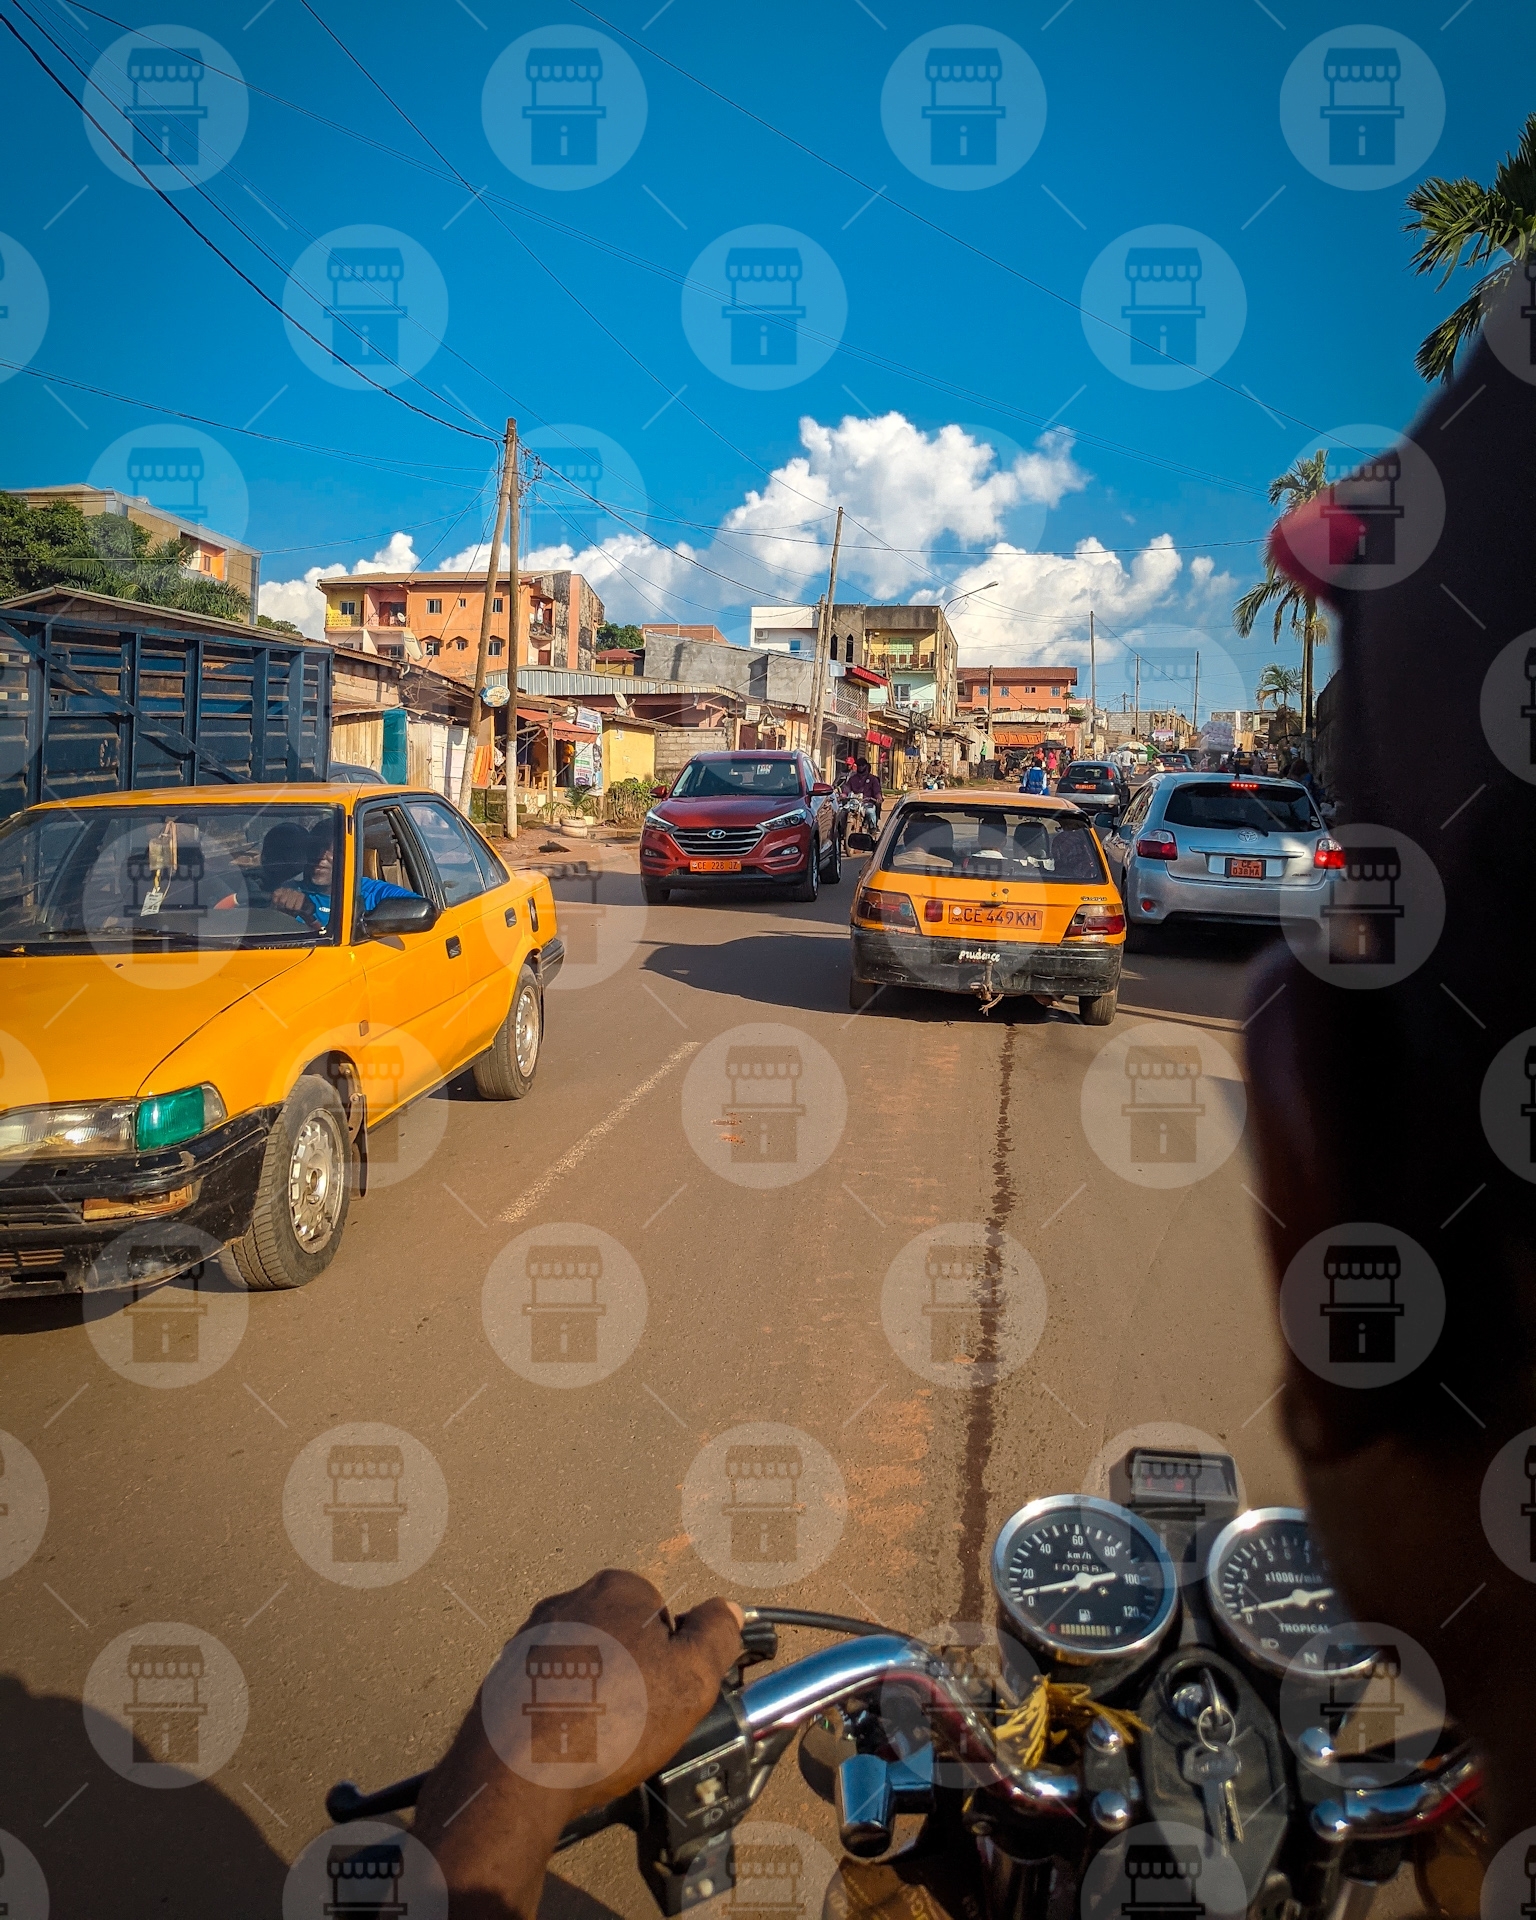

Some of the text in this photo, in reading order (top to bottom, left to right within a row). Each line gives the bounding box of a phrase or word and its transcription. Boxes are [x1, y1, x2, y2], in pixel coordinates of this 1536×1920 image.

[697, 861, 707, 869] CE
[963, 908, 983, 923] CE
[1072, 1535, 1084, 1546] 60
[1040, 1543, 1051, 1554] 40
[1104, 1545, 1116, 1557] 80
[1067, 1551, 1092, 1560] km/h
[1267, 1551, 1275, 1562] 5
[1251, 1557, 1258, 1568] 4
[1022, 1568, 1034, 1579] 20
[1123, 1573, 1140, 1585] 100
[1241, 1568, 1249, 1580] 3
[1236, 1582, 1244, 1595] 2
[1028, 1596, 1035, 1607] 0
[1123, 1605, 1139, 1618] 120
[1245, 1612, 1253, 1625] 0
[1279, 1623, 1330, 1634] TROPICAL
[1303, 1652, 1318, 1665] N
